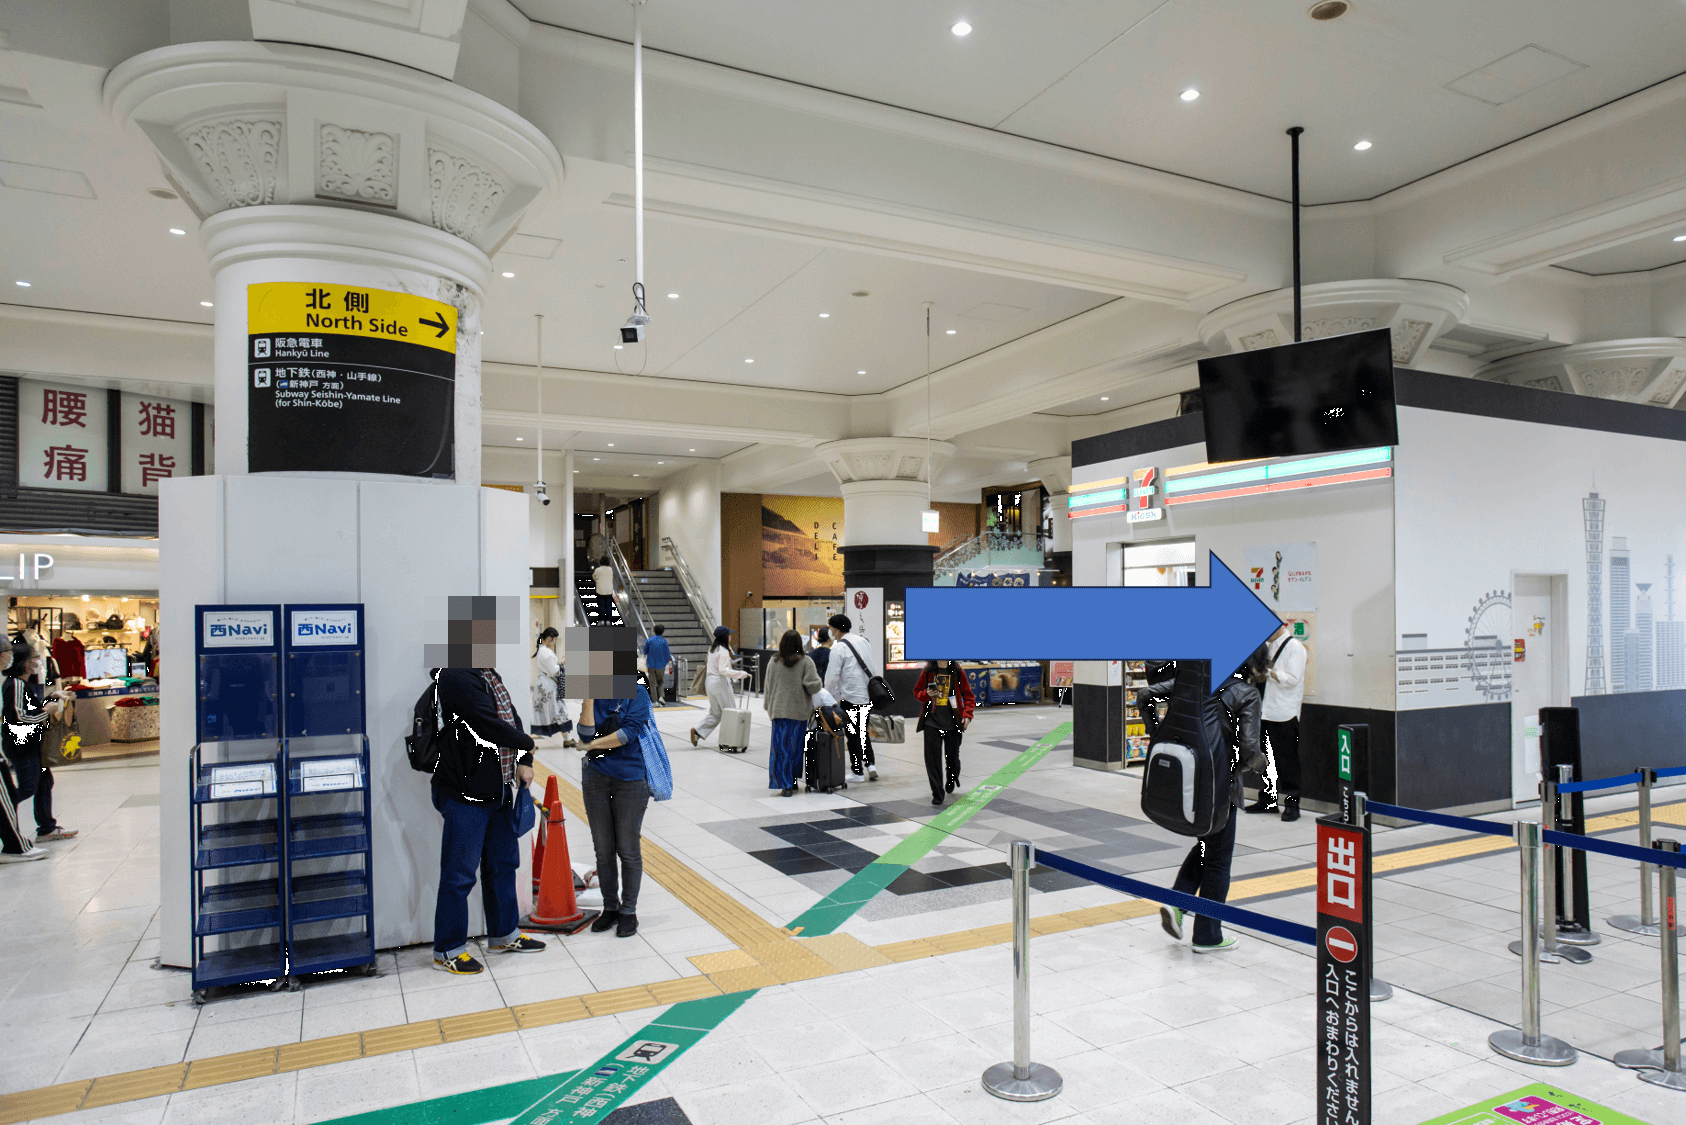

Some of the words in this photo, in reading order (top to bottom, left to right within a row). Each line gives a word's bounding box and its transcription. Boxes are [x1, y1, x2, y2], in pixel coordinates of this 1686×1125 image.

[306, 313, 363, 331] North
[369, 318, 408, 336] Side
[275, 338, 323, 348] 阪急電車
[275, 350, 308, 358] Hankyū
[310, 350, 330, 358] Line
[275, 390, 309, 400] Subway
[311, 390, 380, 402] Seishin-Yamate
[382, 395, 401, 404] Line
[275, 399, 291, 408] (for
[41, 389, 89, 482] 腰痛
[210, 623, 267, 637] 西Navi
[298, 622, 351, 636] 西Navi
[1341, 735, 1350, 774] 入口
[1327, 836, 1355, 909] 出口
